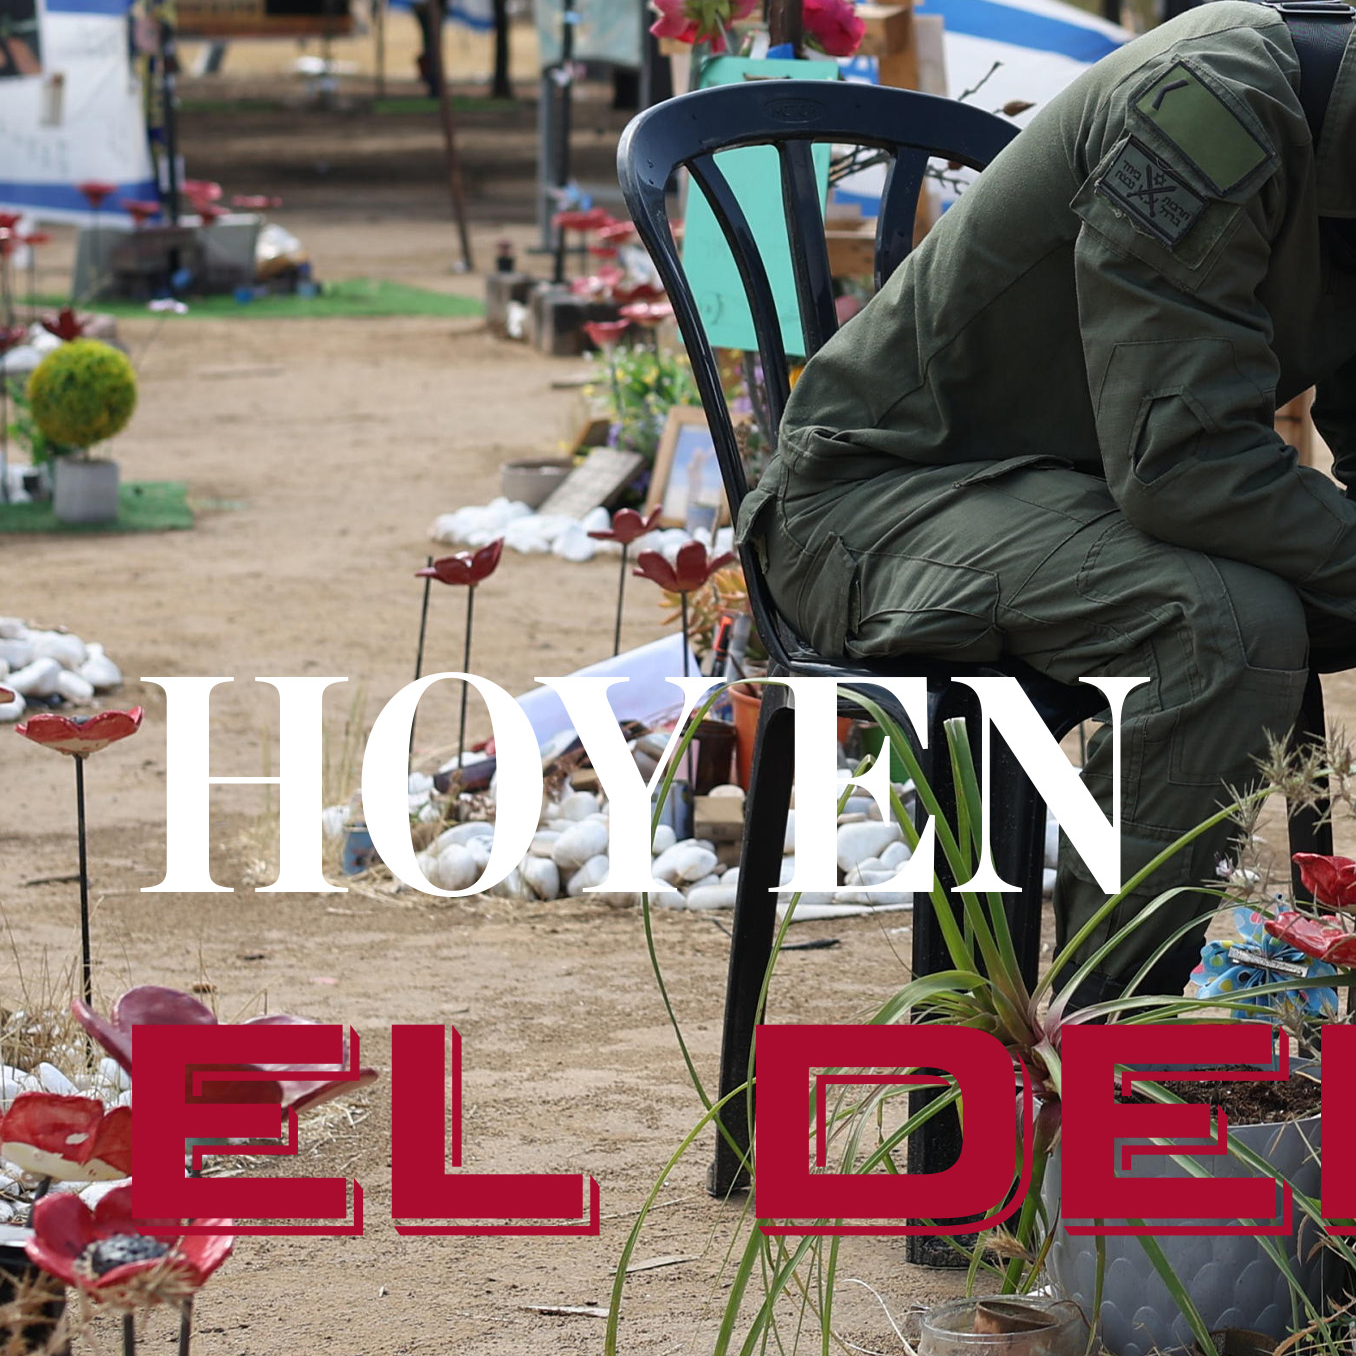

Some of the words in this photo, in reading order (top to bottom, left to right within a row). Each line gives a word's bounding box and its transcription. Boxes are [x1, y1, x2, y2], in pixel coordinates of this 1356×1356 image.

[1123, 160, 1142, 181] ביחד
[1160, 205, 1181, 228] ברזל
[1162, 196, 1191, 221] חרבות
